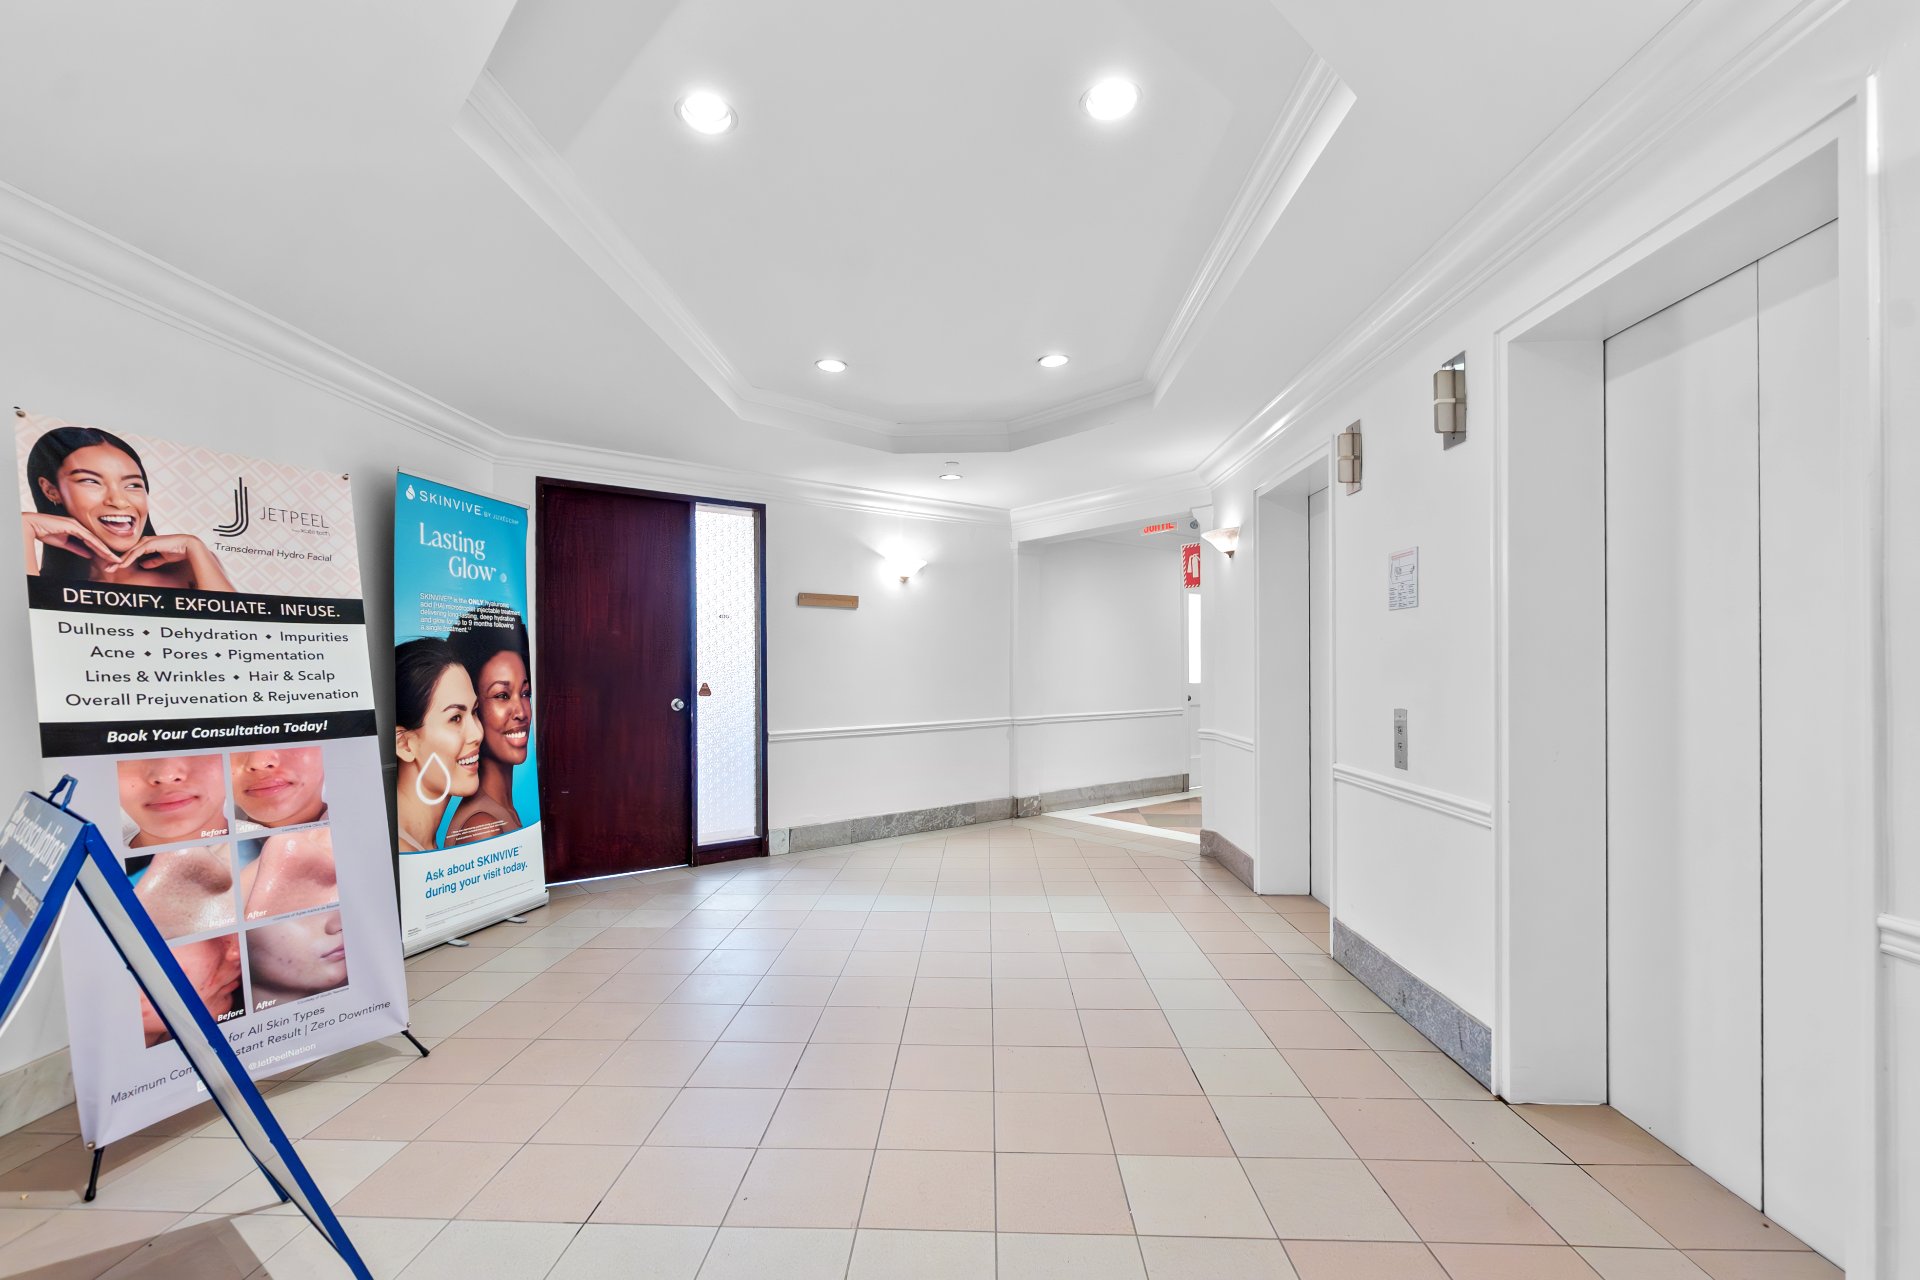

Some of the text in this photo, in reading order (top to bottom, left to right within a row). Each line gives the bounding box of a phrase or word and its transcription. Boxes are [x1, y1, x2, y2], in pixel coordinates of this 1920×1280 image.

[420, 490, 482, 516] SKINVIVE
[260, 506, 330, 529] JETPEEL
[420, 522, 486, 560] Lasting
[215, 543, 332, 562] Transdermal Hydro Facial
[63, 587, 341, 618] DETOXIFY. EXFOLIATE. INFUSE.
[420, 609, 446, 617] delivering
[476, 606, 500, 615] injectable
[58, 622, 349, 644] Dullness Dehydration Impurities
[494, 621, 514, 630] following
[90, 646, 324, 664] Acne Pores Pigmentation
[86, 669, 336, 684] Lines & Wrinkles Hair & Scalp
[65, 688, 359, 709] Overall Prejuvenation & Rejuvenation
[107, 720, 328, 744] Book Your Consultation Today!
[200, 827, 228, 838] Before
[425, 868, 444, 883] Ask
[447, 859, 475, 876] about
[425, 861, 528, 899] during your visit today.
[208, 916, 236, 928] Before
[247, 910, 268, 920] After
[256, 998, 276, 1010] After
[217, 1008, 244, 1022] Before
[228, 1006, 326, 1043] for All Skin Types
[235, 1000, 392, 1057] stant Result Zero Downtime
[110, 1076, 166, 1105] Maximum
